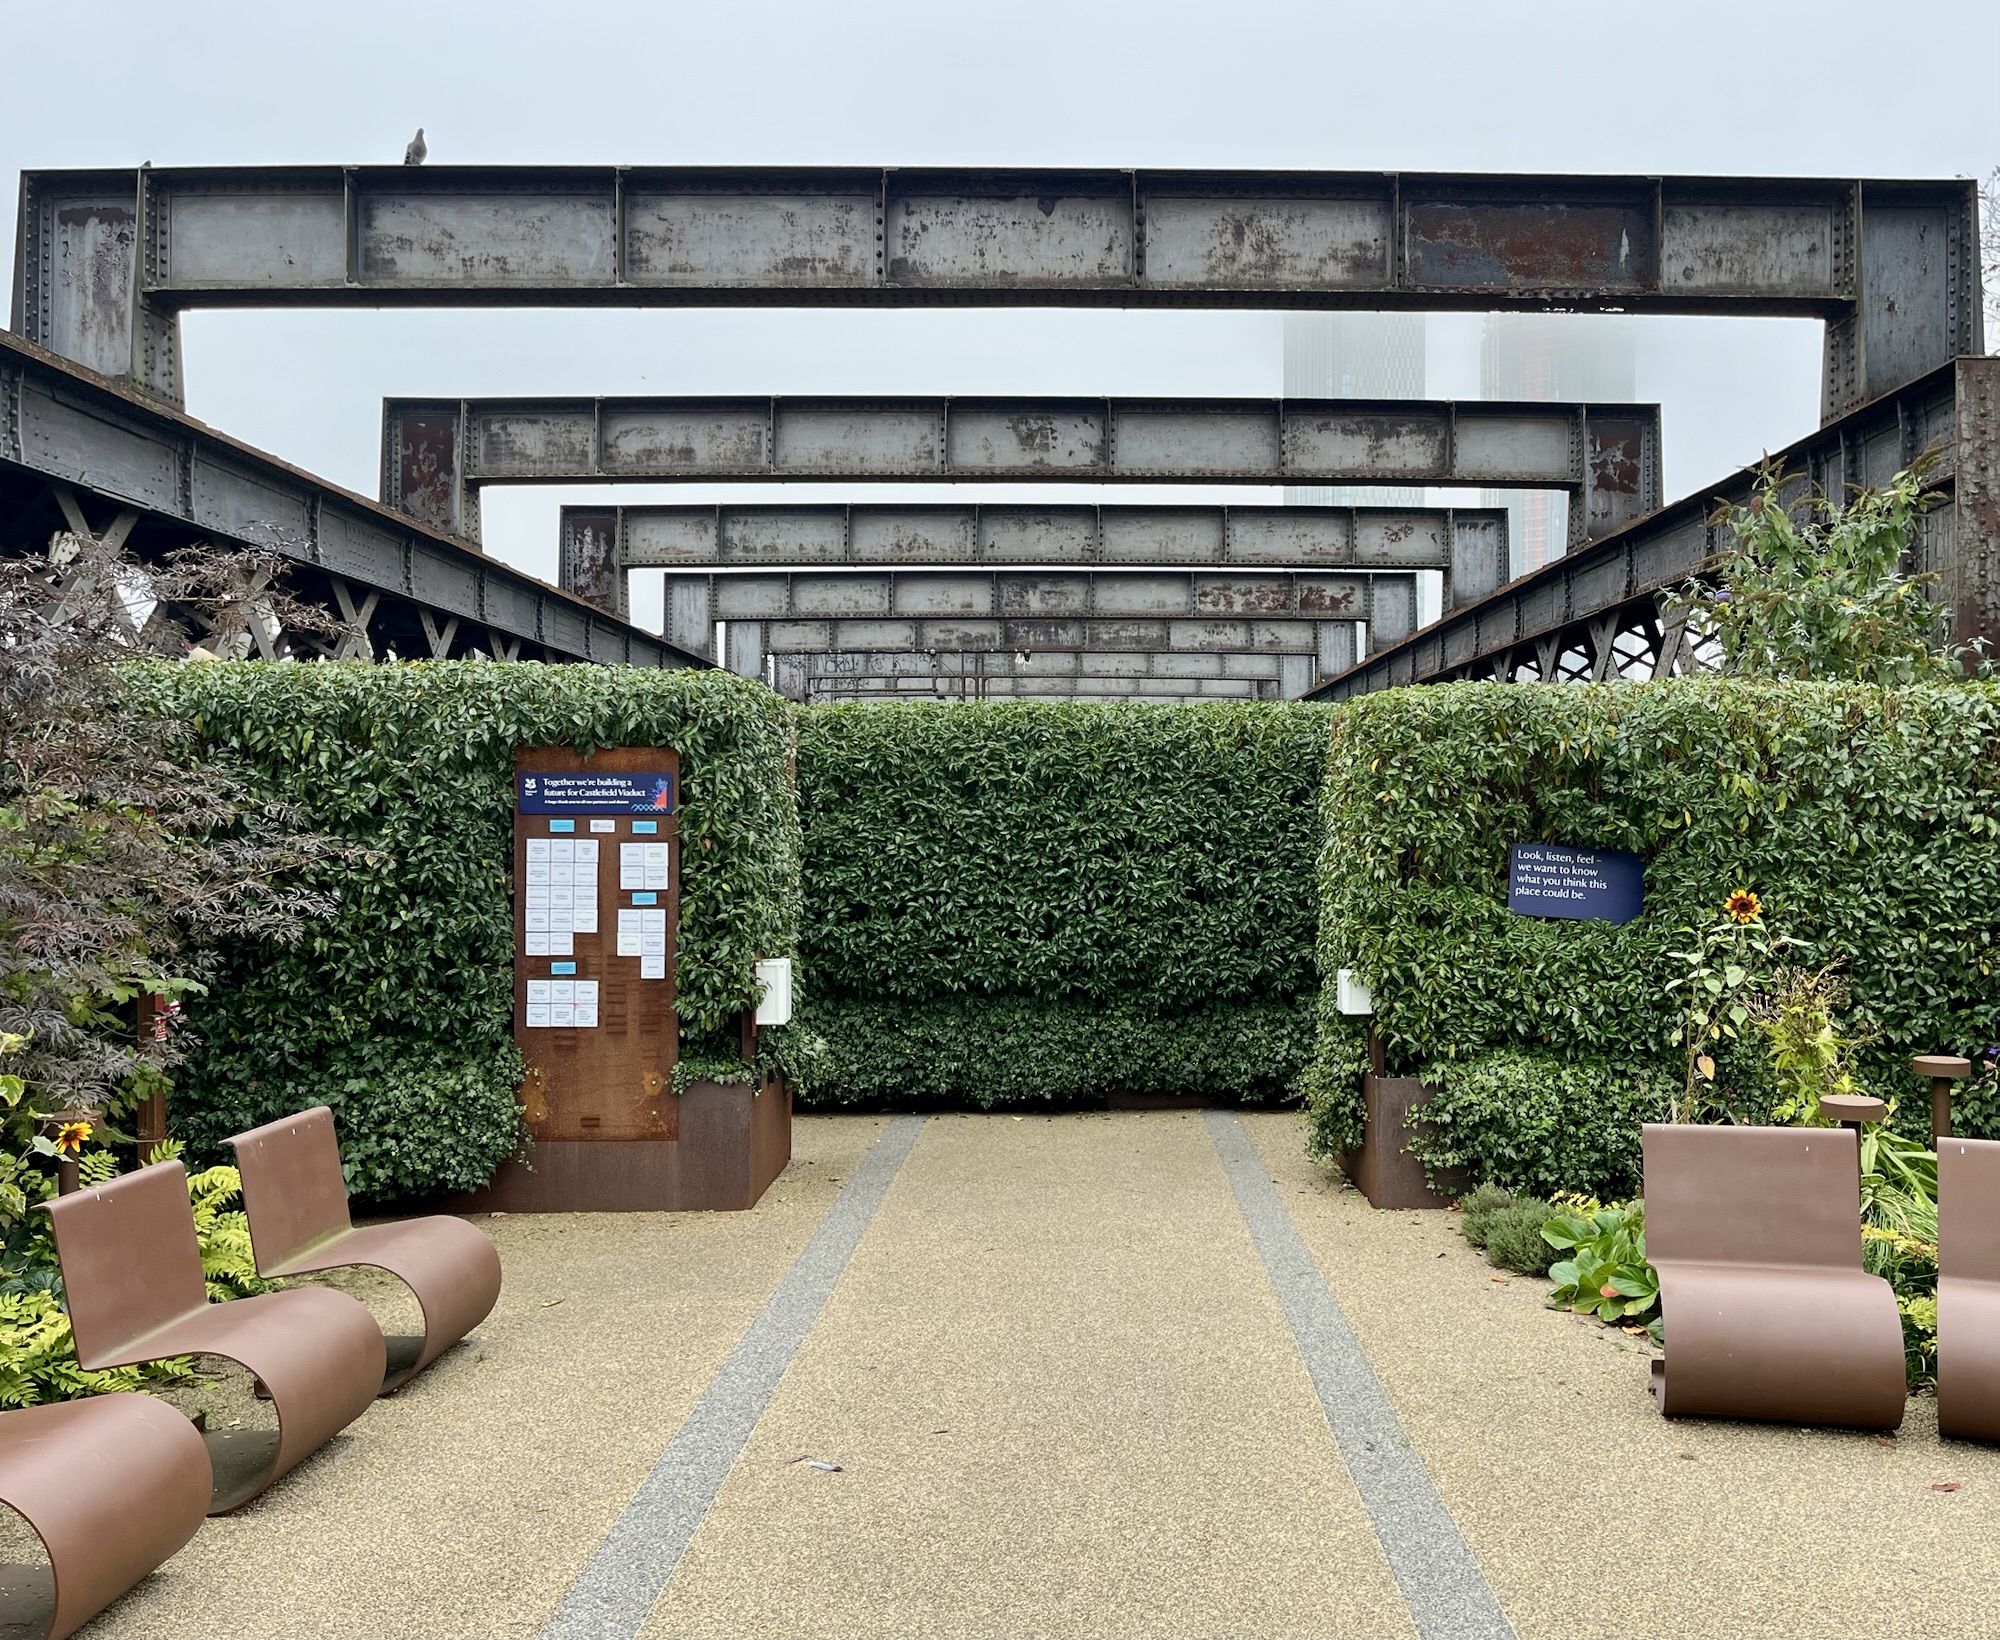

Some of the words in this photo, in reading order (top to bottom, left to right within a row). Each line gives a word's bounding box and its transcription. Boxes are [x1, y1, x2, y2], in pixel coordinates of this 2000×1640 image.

[543, 778, 575, 788] Together
[576, 778, 596, 786] we're
[597, 778, 626, 788] building
[544, 789, 566, 797] future
[1518, 850, 1543, 861] Look,
[1546, 852, 1574, 864] listen,
[1577, 854, 1594, 864] feel
[1518, 863, 1532, 871] we
[1534, 865, 1556, 873] want
[1572, 866, 1598, 876] know
[1517, 874, 1540, 884] what
[1542, 878, 1560, 886] you
[1563, 878, 1587, 888] think
[1589, 880, 1607, 889] this
[1515, 886, 1540, 896] place
[1542, 889, 1569, 898] could
[1571, 890, 1586, 899] be.
